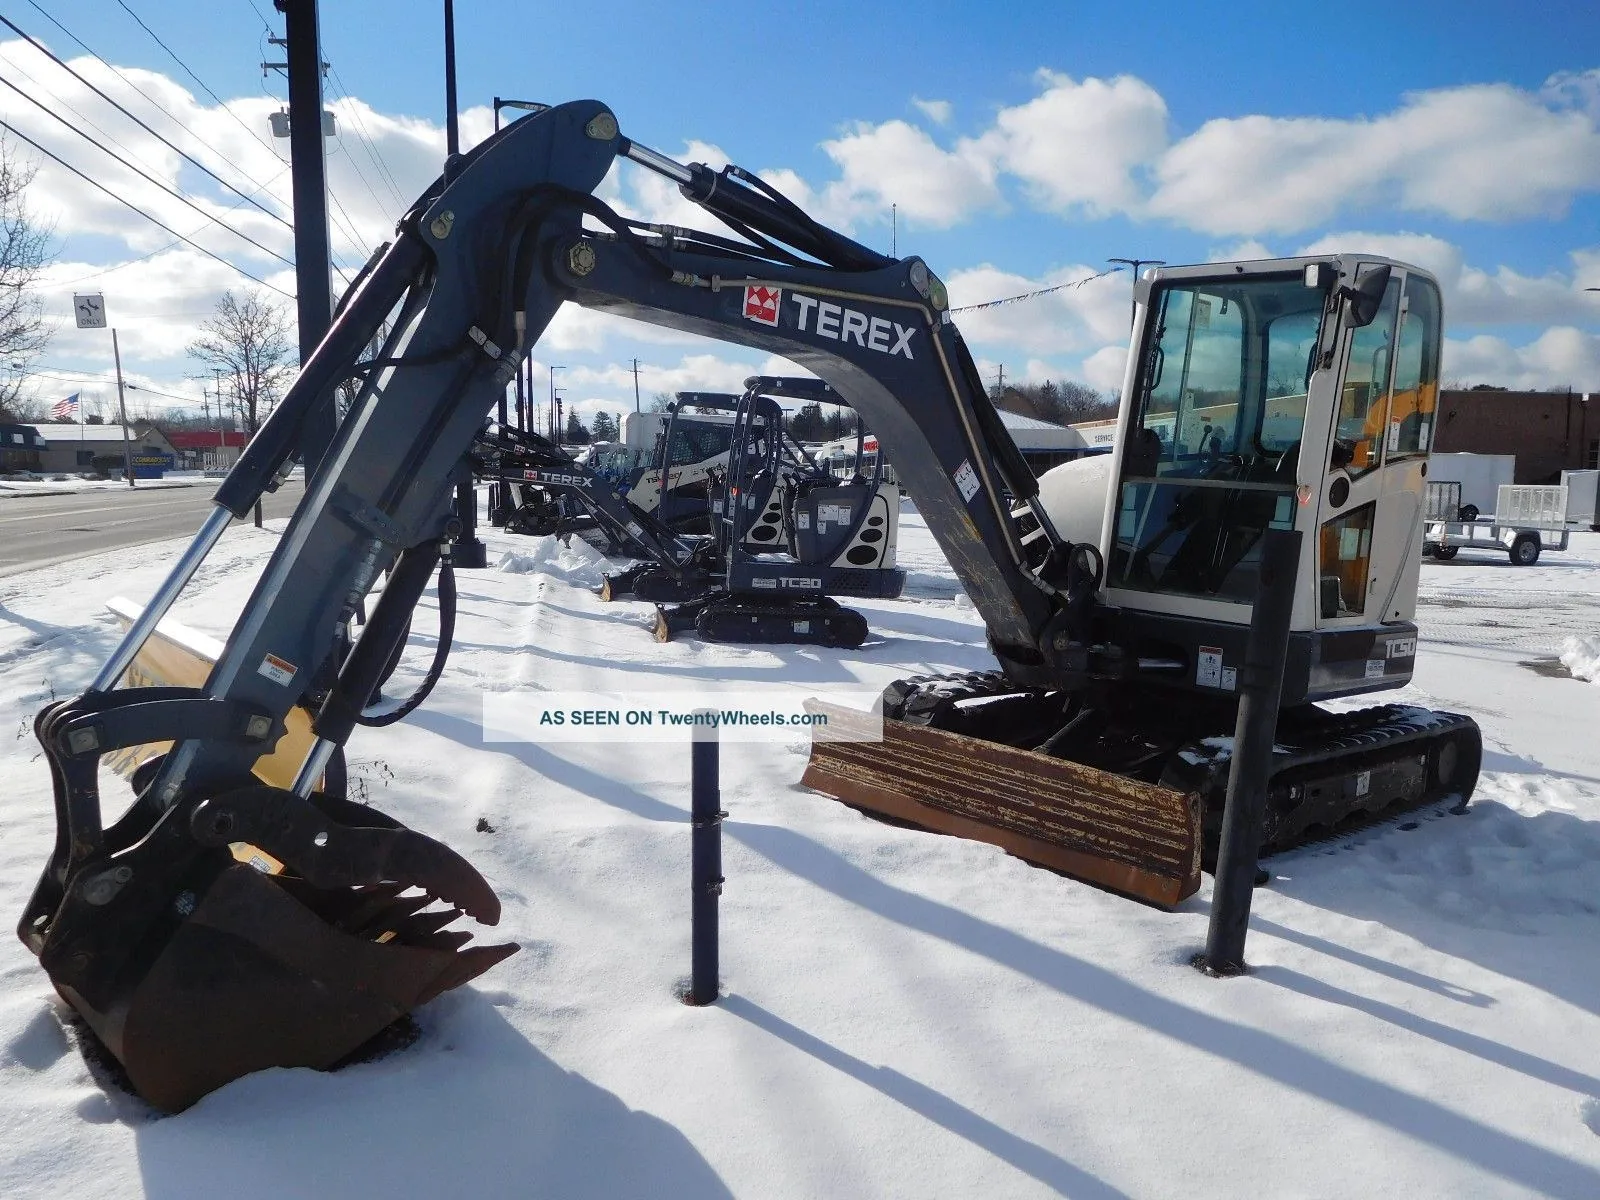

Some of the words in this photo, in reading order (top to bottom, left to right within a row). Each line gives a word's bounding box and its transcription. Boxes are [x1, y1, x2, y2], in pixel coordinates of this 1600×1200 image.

[791, 292, 917, 360] TEREX
[1094, 434, 1113, 443] SERVICE
[540, 472, 594, 488] TEREX
[779, 577, 822, 589] TC20
